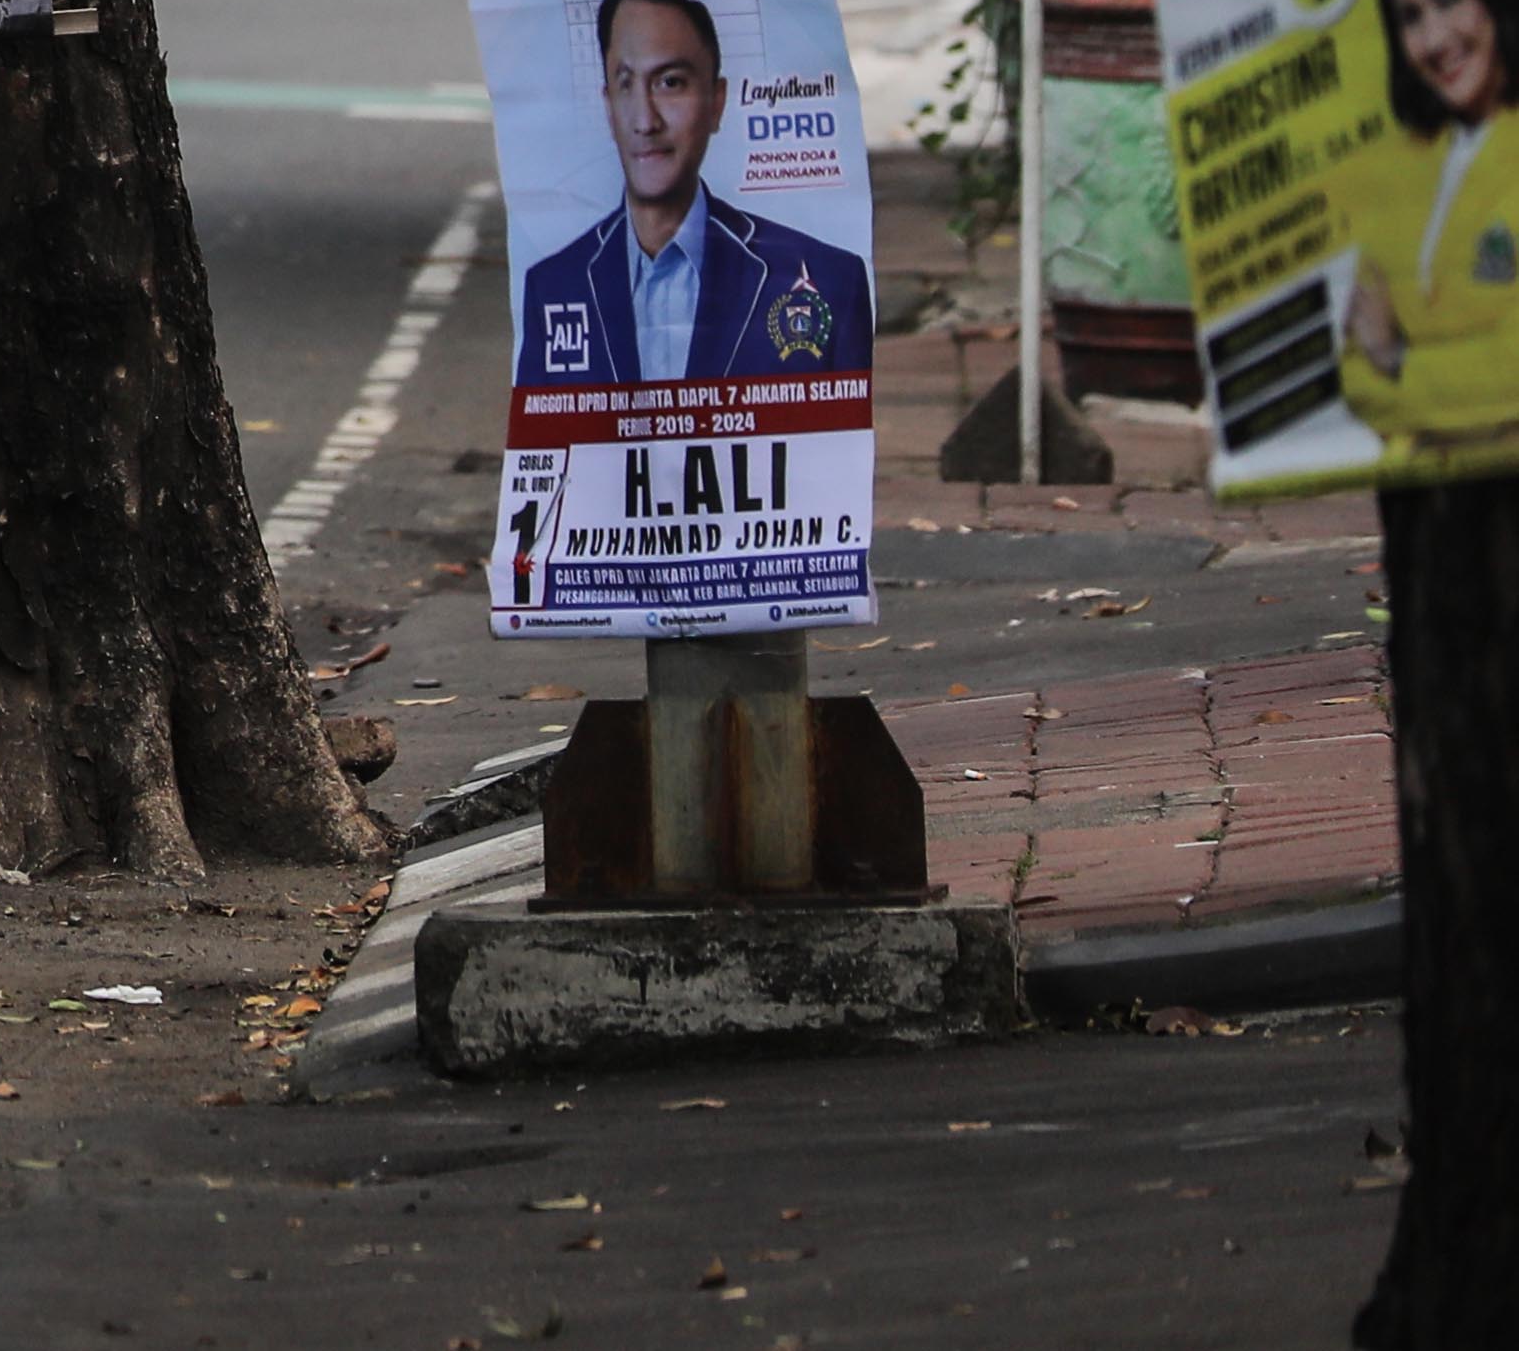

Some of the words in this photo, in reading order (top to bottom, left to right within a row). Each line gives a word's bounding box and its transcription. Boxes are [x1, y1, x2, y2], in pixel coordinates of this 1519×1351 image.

[741, 76, 822, 108] Lanjutkan
[748, 112, 835, 141] DPRD
[749, 152, 798, 163] MOHON
[746, 166, 841, 180] DUKUNGANNYA
[553, 322, 582, 352] ALI
[678, 386, 723, 407] DAPIL
[742, 382, 805, 403] JAKARTA
[810, 379, 868, 400] SELATAN
[656, 415, 695, 435] 2019
[713, 412, 755, 432] 2024
[625, 441, 787, 518] H.ALI
[566, 523, 722, 557] MUHAMMAD
[736, 517, 823, 549] JOHAN
[837, 515, 861, 543] C.
[510, 500, 540, 605] 1
[555, 567, 590, 586] CALEG
[594, 566, 624, 585] DPRD
[703, 562, 738, 581] DAPIL
[753, 558, 804, 577] JAKARTA
[809, 555, 858, 575] SELATAN
